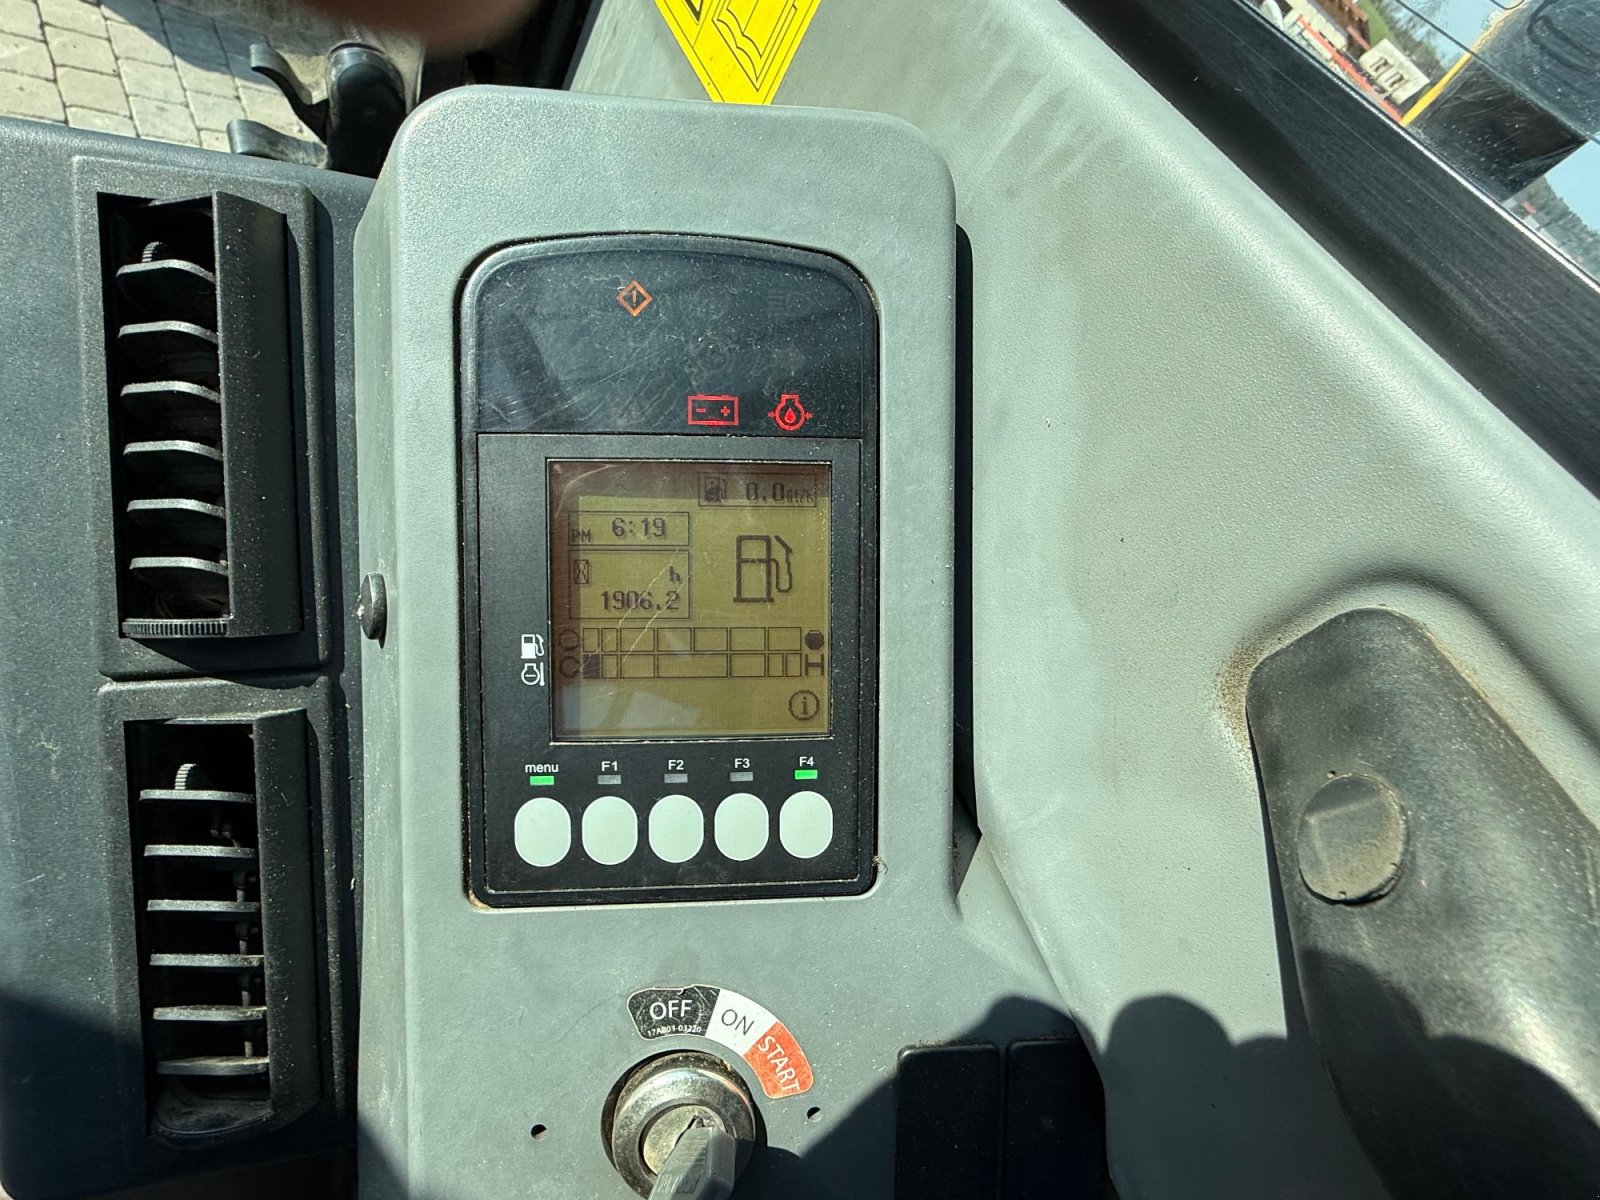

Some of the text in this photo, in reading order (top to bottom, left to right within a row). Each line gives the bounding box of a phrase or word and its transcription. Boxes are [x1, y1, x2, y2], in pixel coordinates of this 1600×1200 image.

[571, 517, 667, 544] PM 6:19
[600, 590, 680, 611] 1906.2
[525, 762, 559, 774] menu
[601, 760, 619, 772] F1
[668, 759, 685, 771] F2
[734, 758, 750, 769] F3
[799, 756, 814, 768] F4
[649, 999, 693, 1020] OFF
[721, 1008, 754, 1036] ON
[757, 1036, 801, 1092] START
